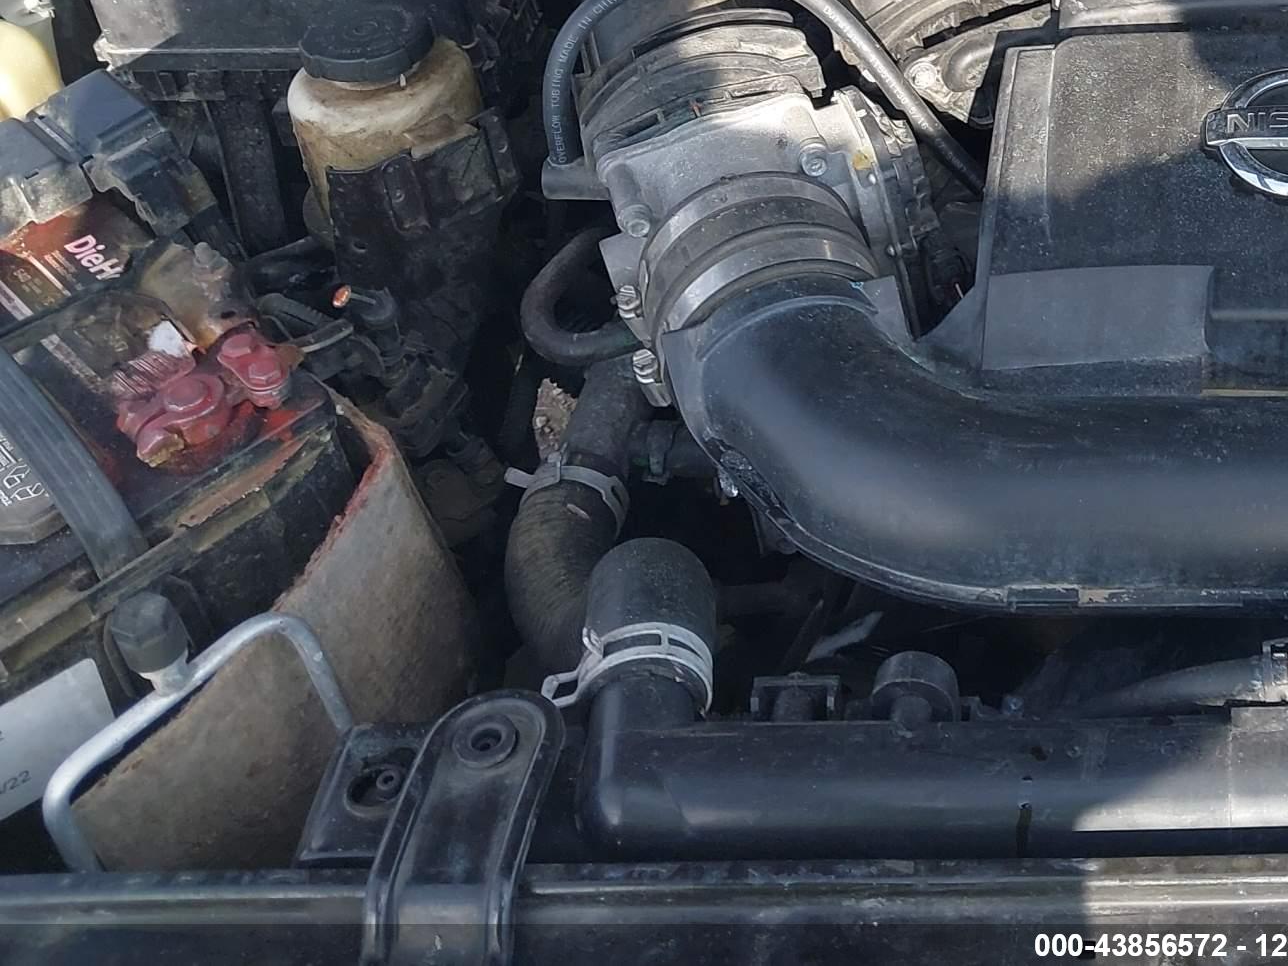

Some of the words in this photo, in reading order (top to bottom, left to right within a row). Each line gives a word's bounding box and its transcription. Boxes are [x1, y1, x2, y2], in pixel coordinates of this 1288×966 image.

[577, 16, 593, 31] IN
[558, 34, 579, 64] MADE
[551, 68, 565, 108] TUBING
[551, 114, 568, 163] OVERFLOW
[63, 234, 124, 281] DieH
